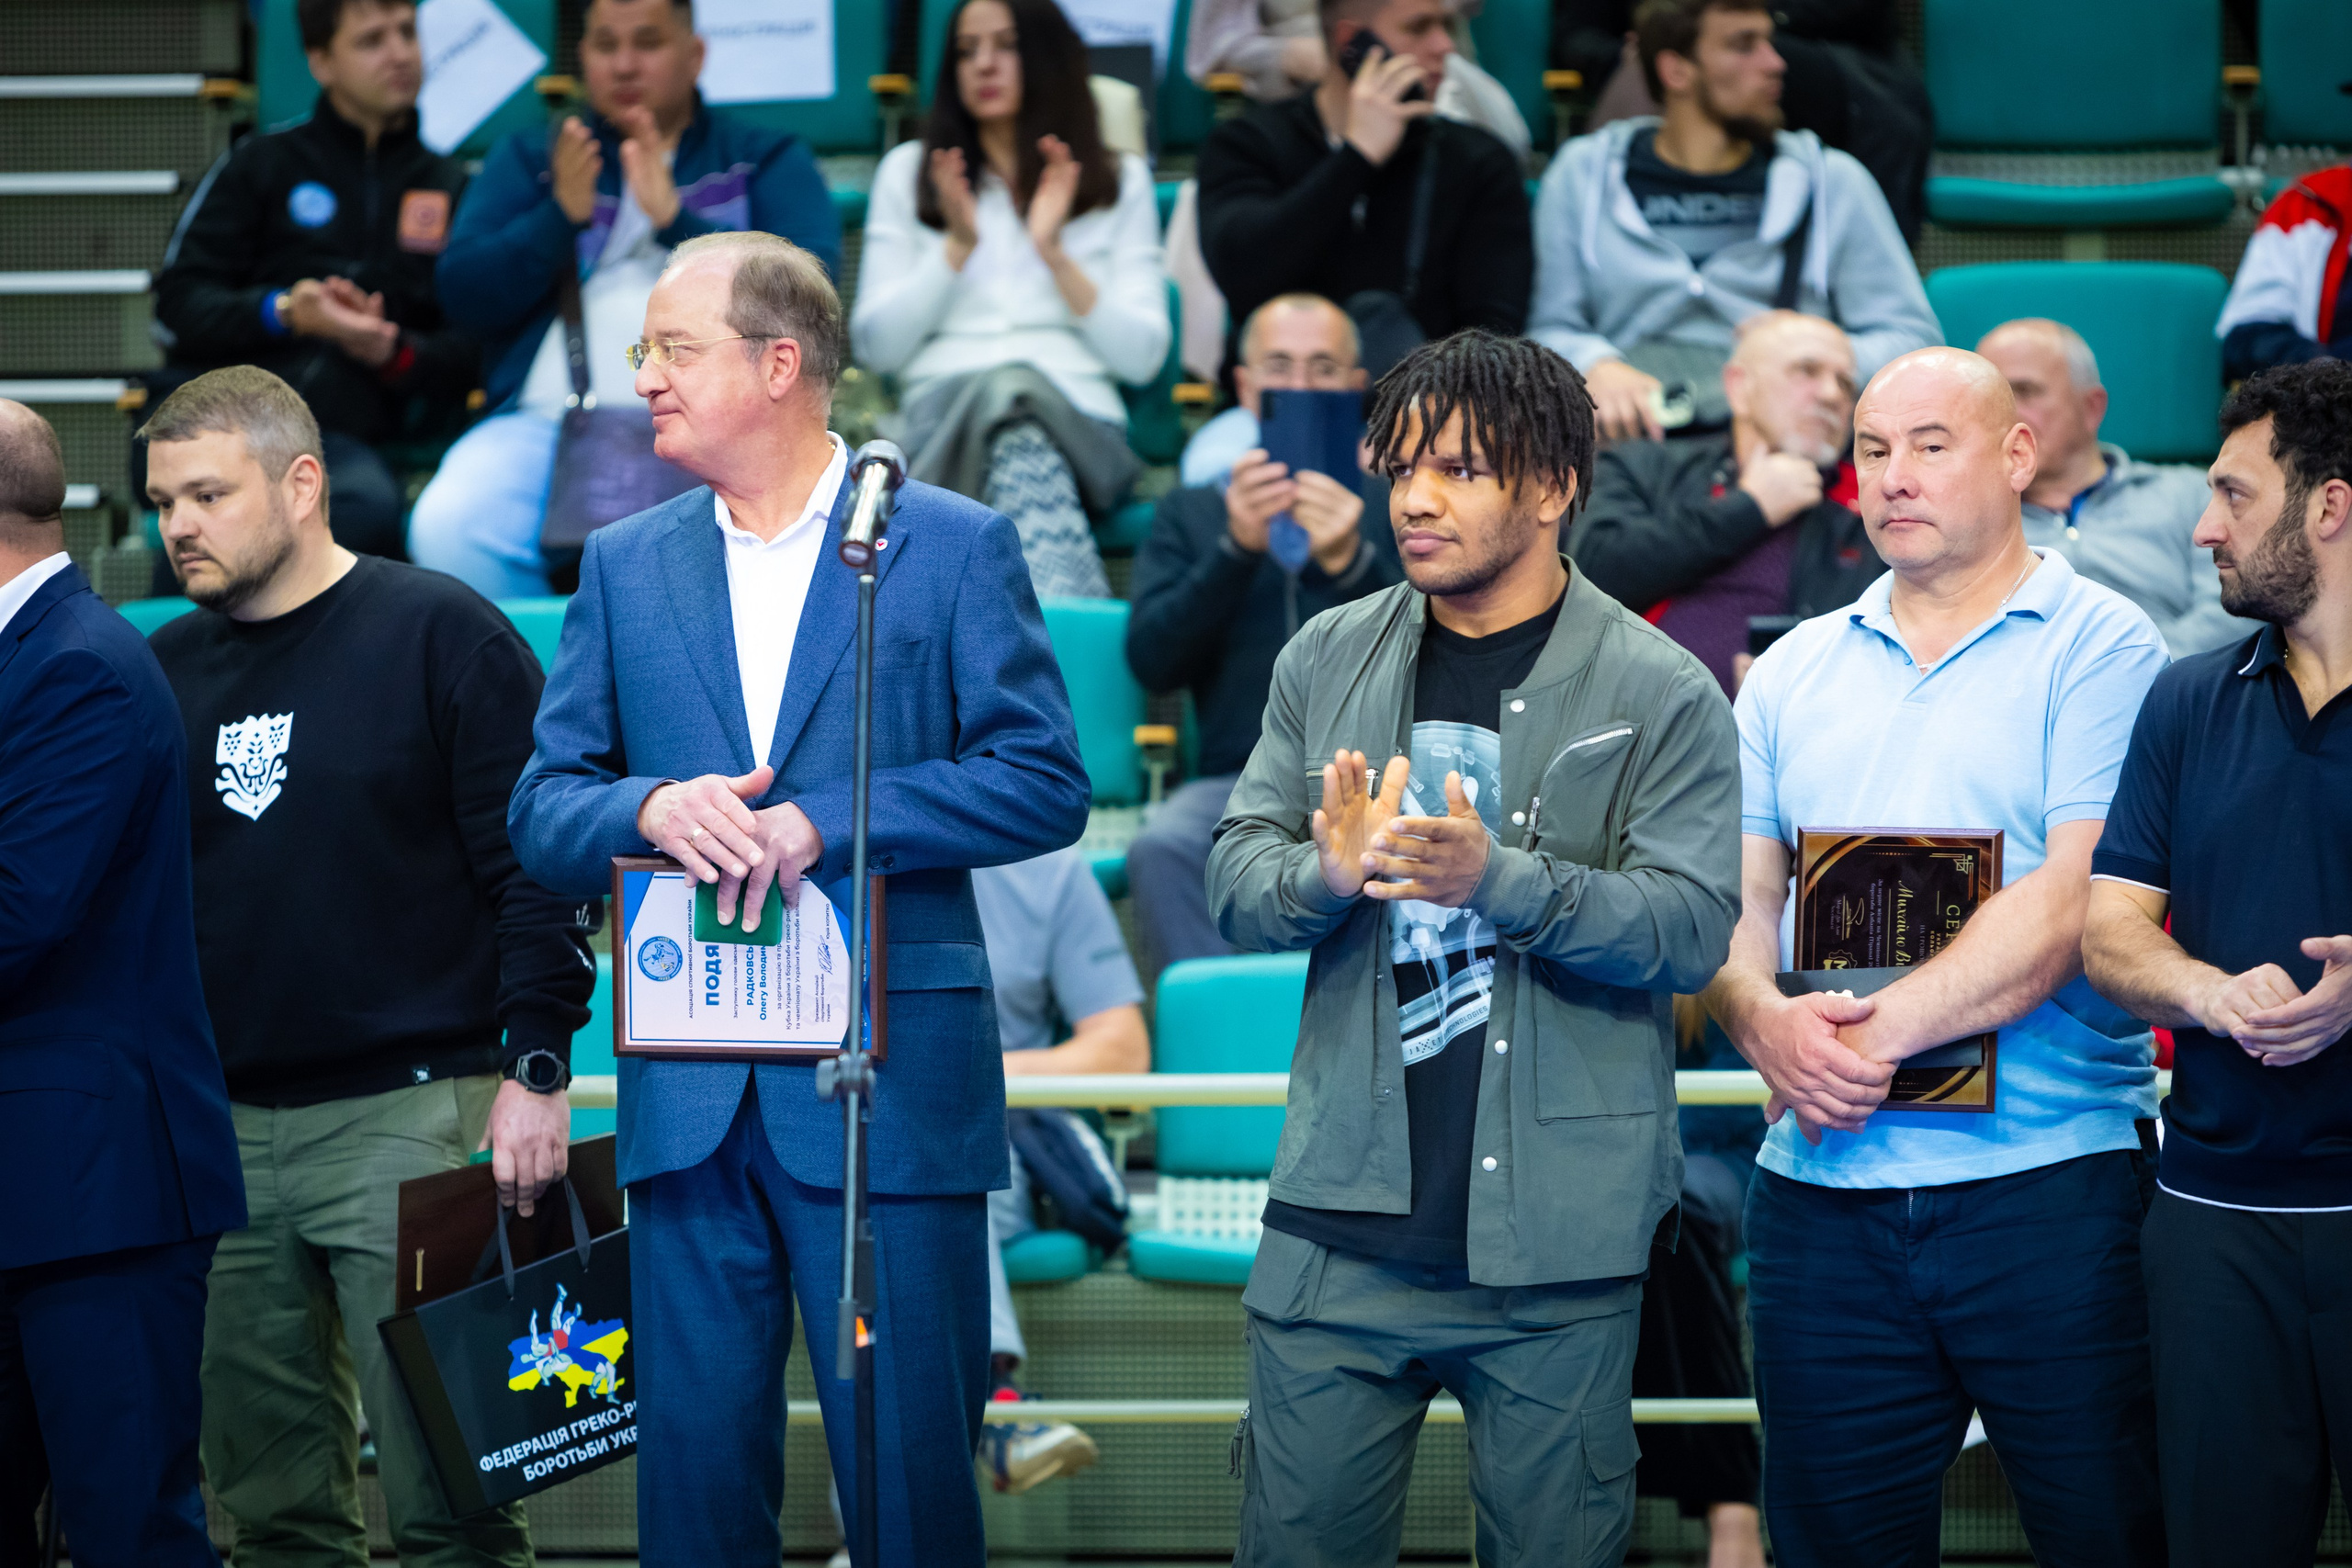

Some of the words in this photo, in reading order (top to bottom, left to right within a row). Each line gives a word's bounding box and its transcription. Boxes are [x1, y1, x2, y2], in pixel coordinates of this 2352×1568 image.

[1896, 880, 1914, 947] Михайло
[706, 945, 721, 1006] ПОДЯ
[746, 944, 755, 1005] РАДКОВСЬ
[760, 990, 768, 1020] Олегу
[480, 1427, 570, 1472] ФЕДЕРАЦІЯ
[523, 1437, 610, 1482] БОРОТЬБИ
[609, 1426, 637, 1450] УКР
